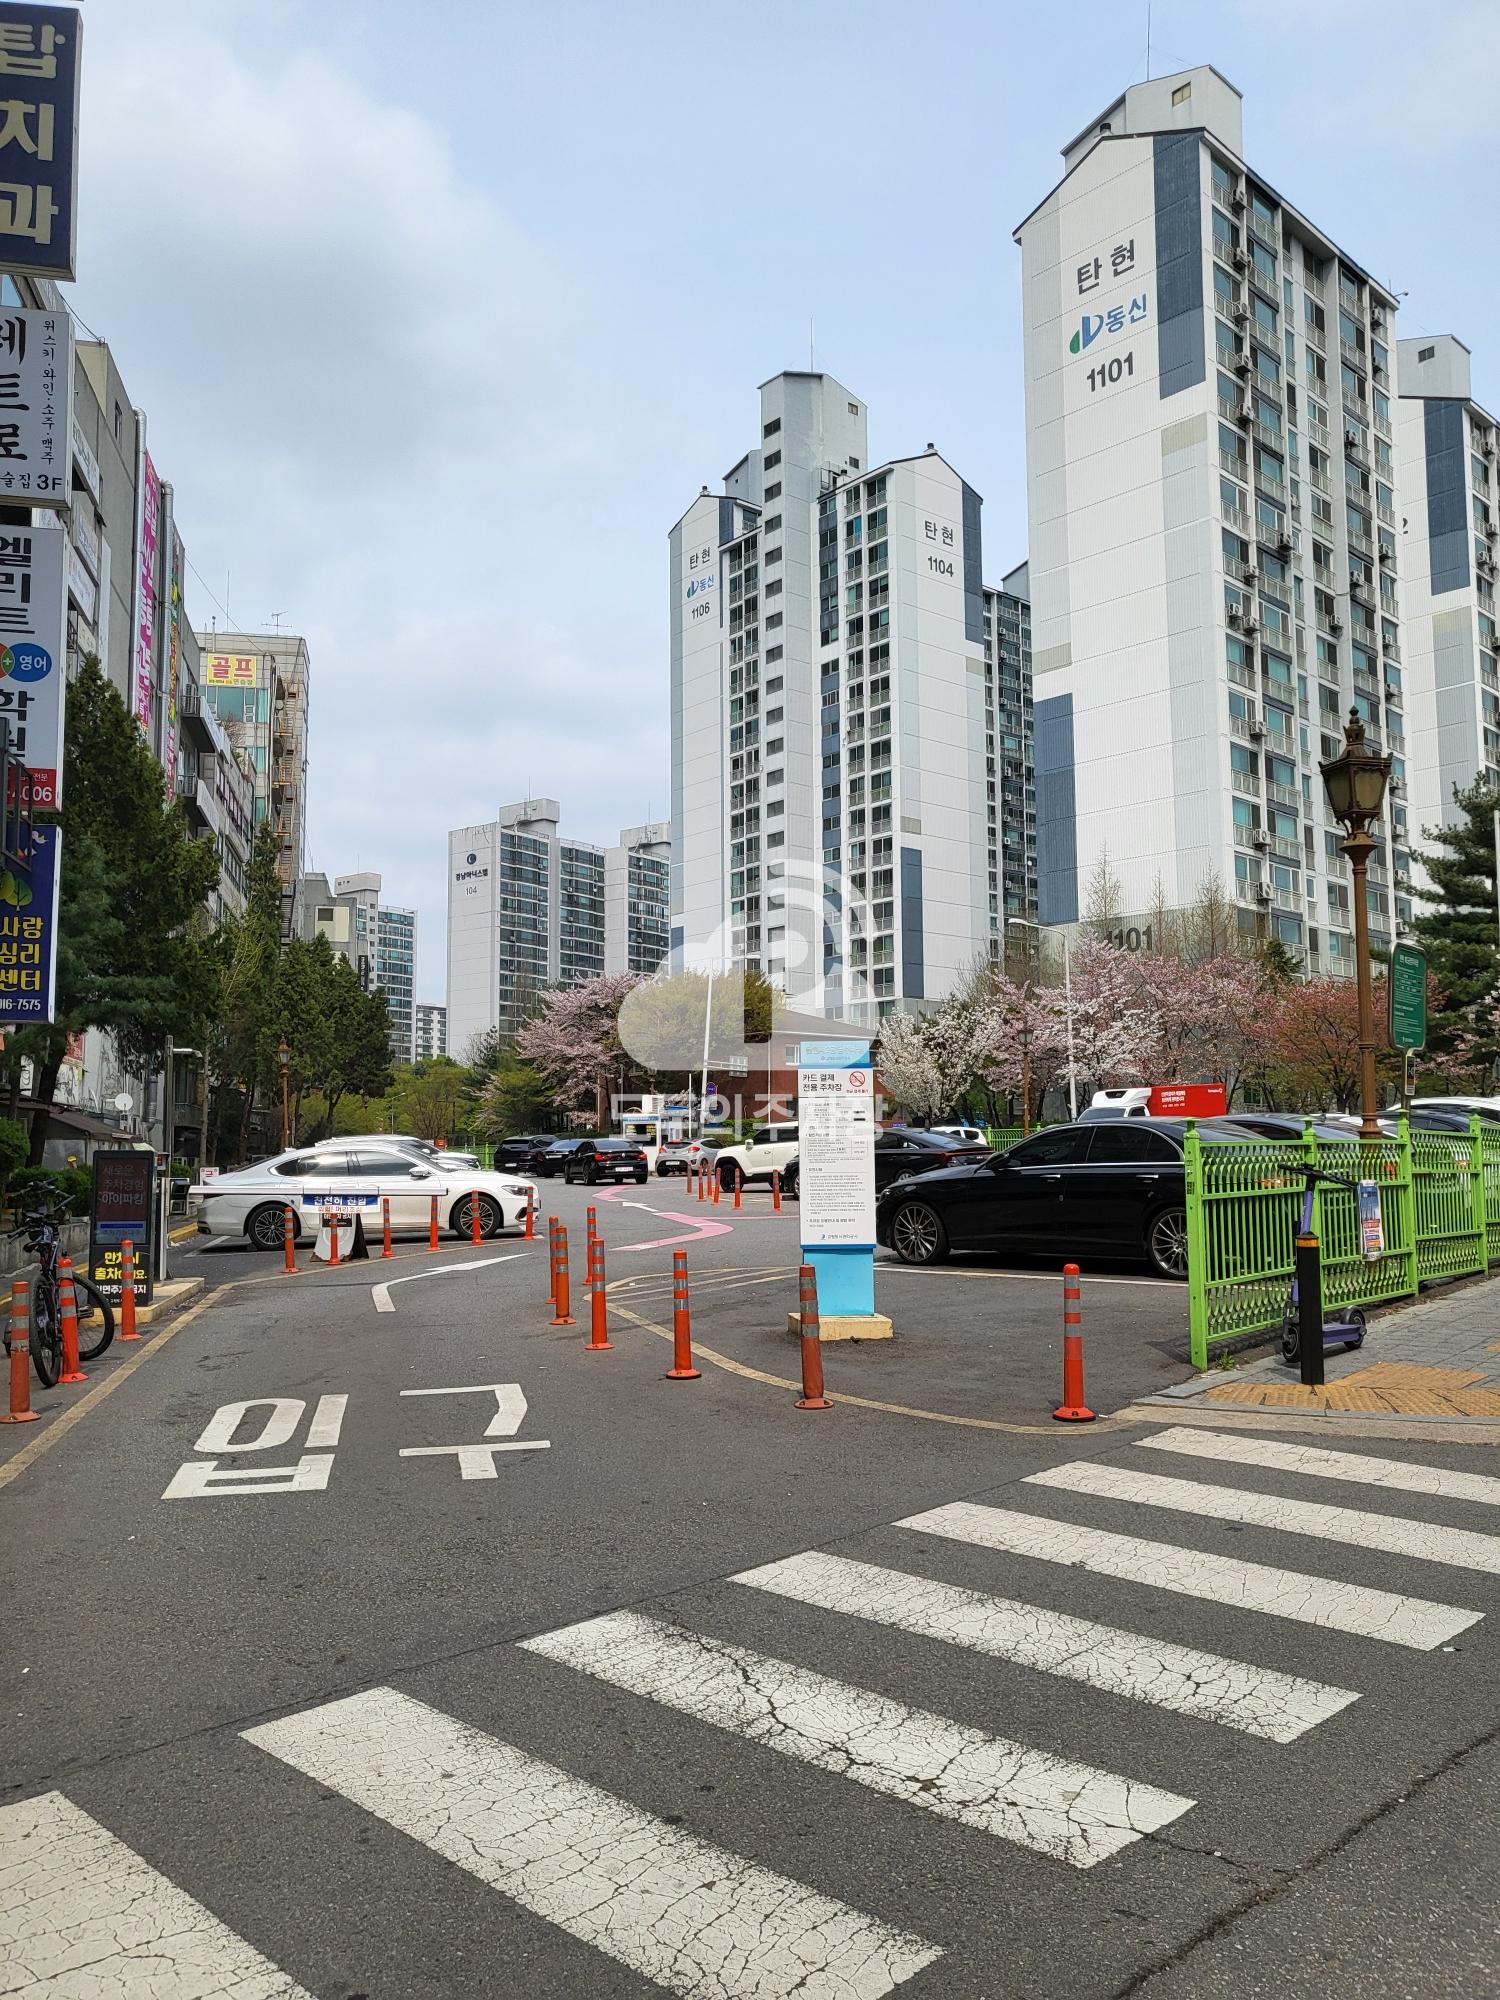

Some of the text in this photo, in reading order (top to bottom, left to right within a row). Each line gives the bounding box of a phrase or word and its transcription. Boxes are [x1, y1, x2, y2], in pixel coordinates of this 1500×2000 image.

[0, 23, 66, 245] 탑치과
[1077, 238, 1135, 295] 탄현
[1105, 293, 1147, 334] 동신
[1086, 351, 1134, 392] 1101
[36, 473, 63, 490] 3F
[924, 519, 954, 547] 탄현
[689, 546, 711, 570] 탄현
[927, 555, 954, 577] 1104
[700, 574, 714, 592] 동신
[691, 601, 711, 619] 1106
[19, 654, 47, 672] 영어
[211, 656, 252, 679] 골프
[465, 885, 478, 896] 104
[0, 943, 40, 965] 심리
[0, 969, 40, 991] 센터
[802, 1073, 835, 1082] 카드 결제
[802, 1083, 842, 1092] 전용 주차장
[95, 1267, 147, 1280] 출차요.
[161, 1384, 550, 1499] 입구
